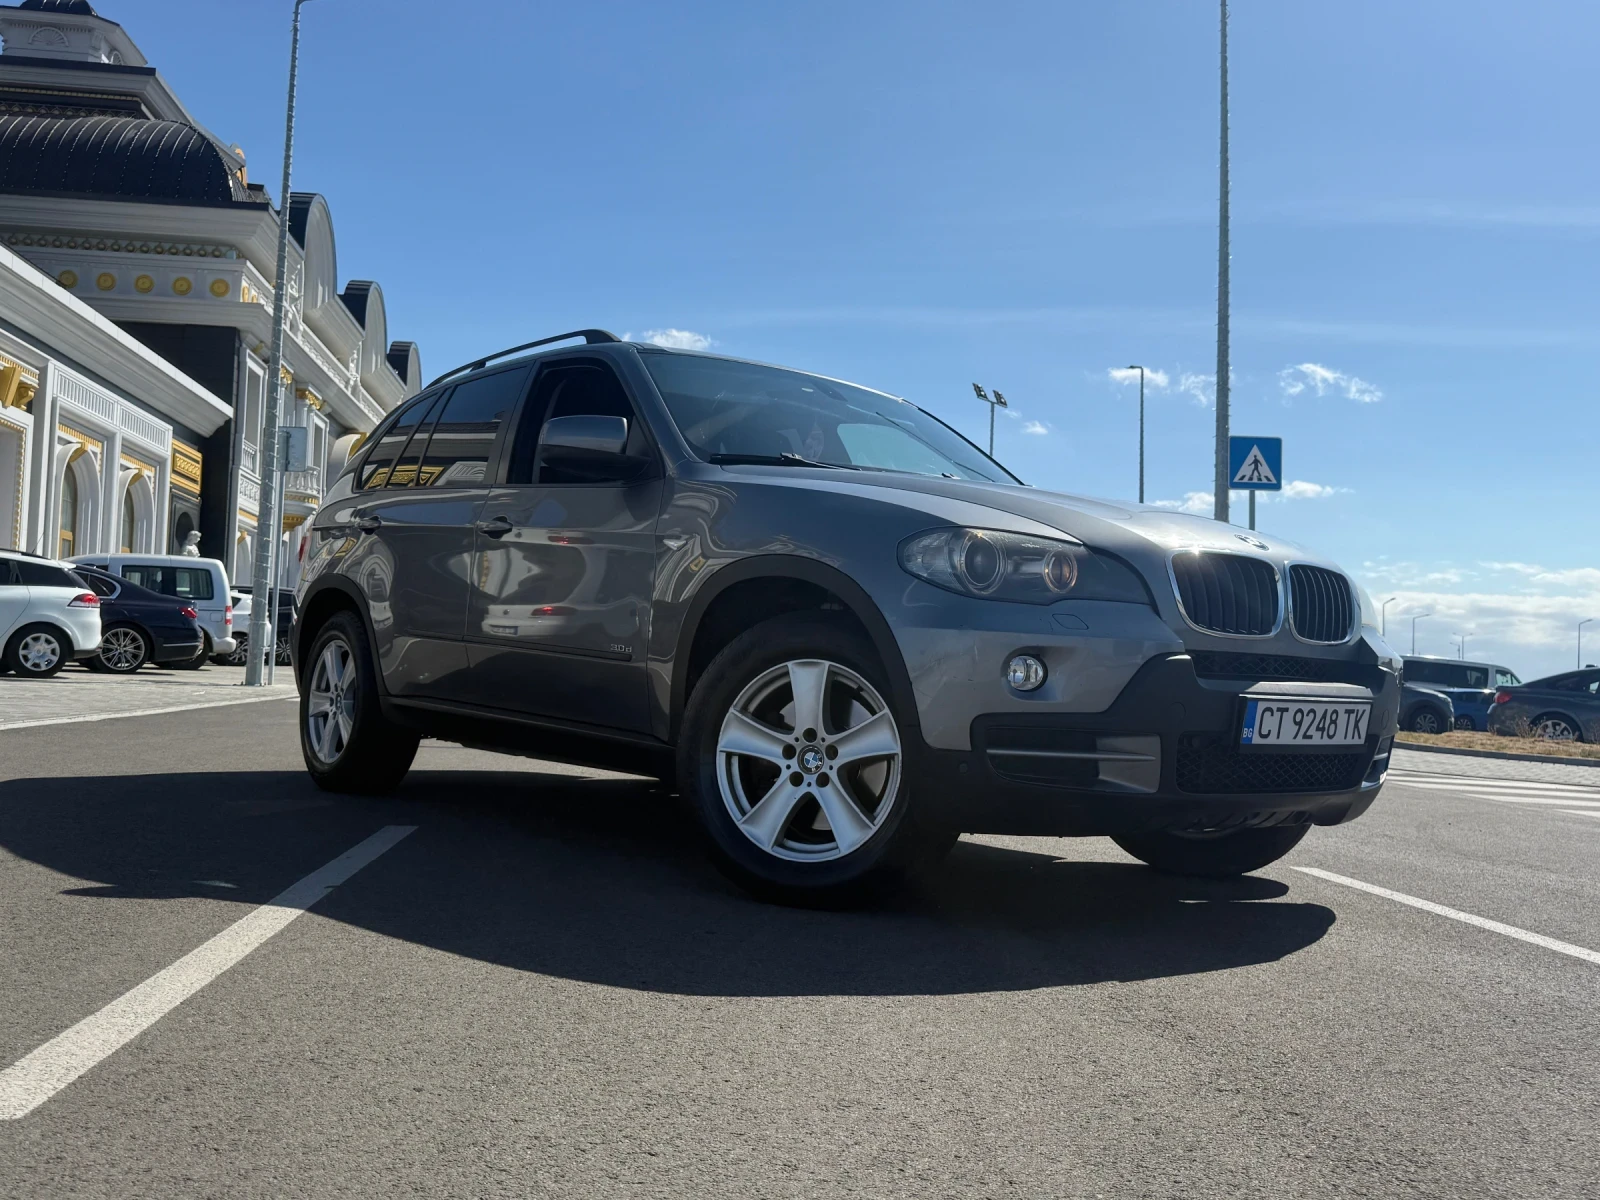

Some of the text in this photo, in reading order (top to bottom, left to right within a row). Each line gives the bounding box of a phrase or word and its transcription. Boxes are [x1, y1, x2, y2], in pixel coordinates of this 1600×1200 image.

[1242, 727, 1253, 738] BG
[1258, 706, 1367, 740] CT 9248 TK
